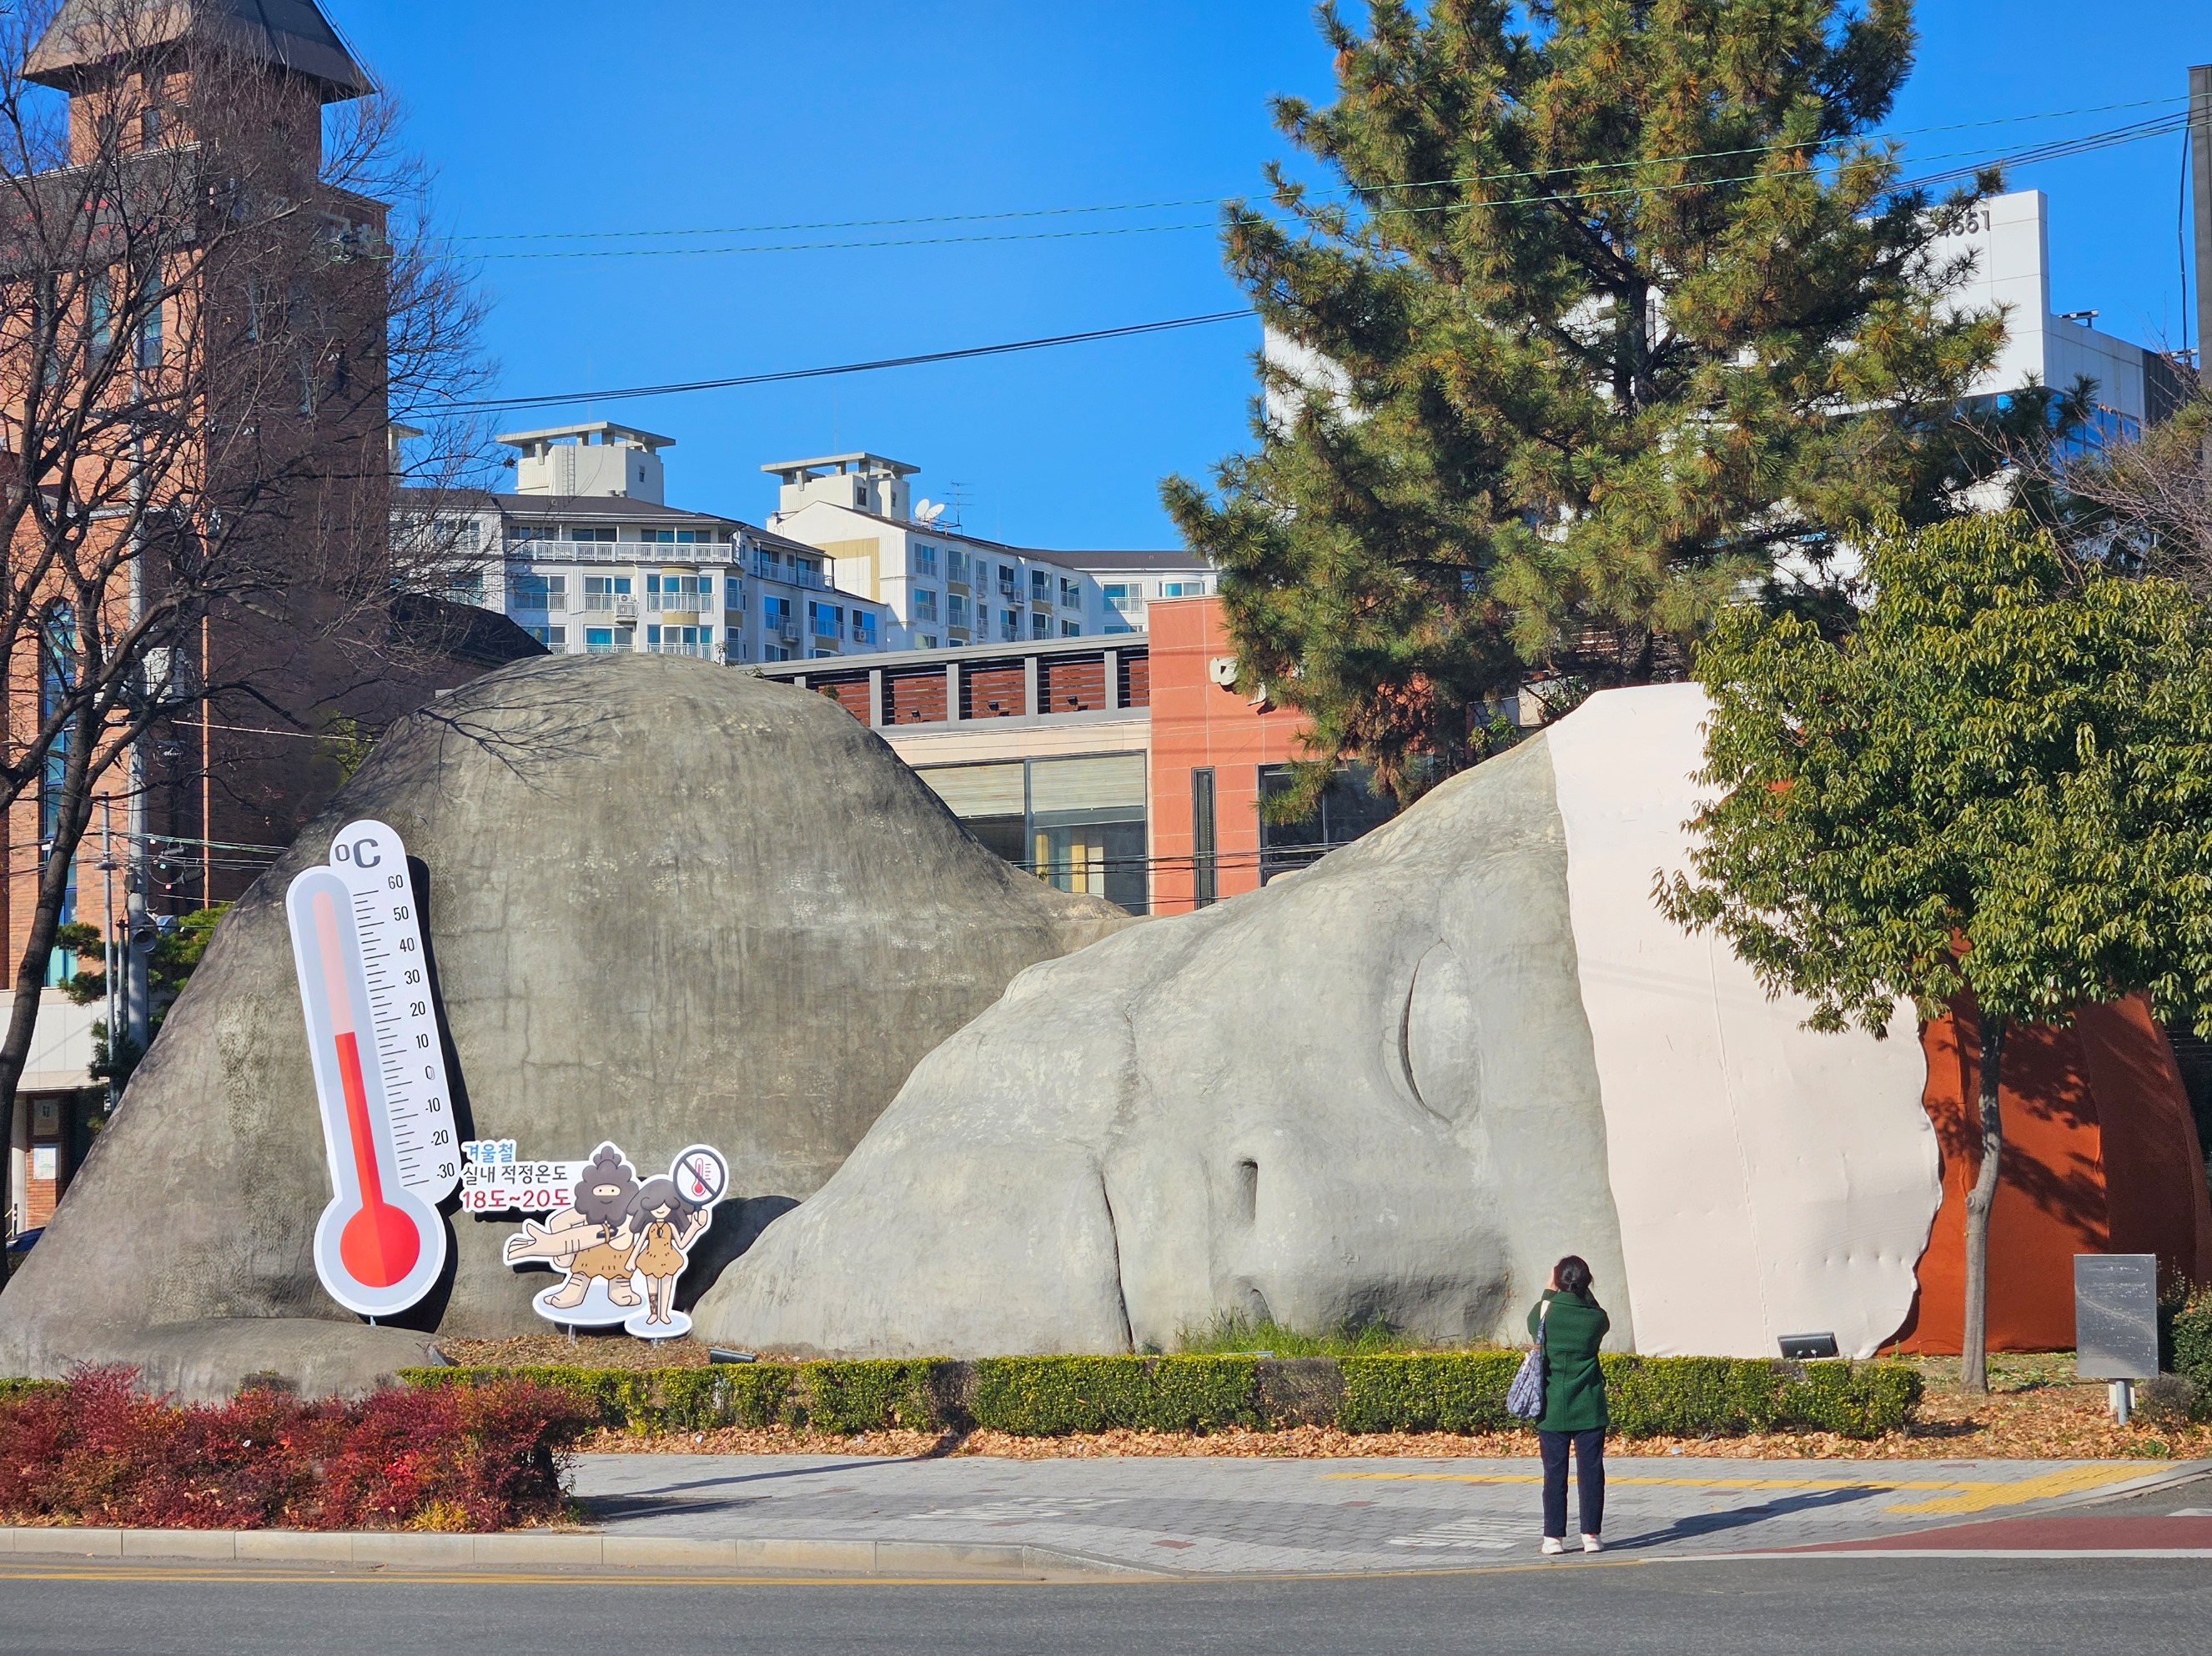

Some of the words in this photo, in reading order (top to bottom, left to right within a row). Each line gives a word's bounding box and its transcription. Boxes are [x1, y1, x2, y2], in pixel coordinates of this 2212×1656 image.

[388, 875, 404, 890] 60
[394, 906, 410, 921] 50
[400, 936, 416, 952] 40
[405, 969, 420, 985] 30
[410, 1001, 426, 1016] 20
[415, 1033, 430, 1049] 10
[425, 1066, 435, 1081] 0
[425, 1097, 441, 1113] -10
[430, 1129, 450, 1145] -20
[464, 1143, 514, 1163] 겨울철
[436, 1162, 455, 1178] -30
[463, 1164, 495, 1185] 실내
[500, 1164, 569, 1185] 적정온도
[462, 1189, 571, 1209] 18도~20도
